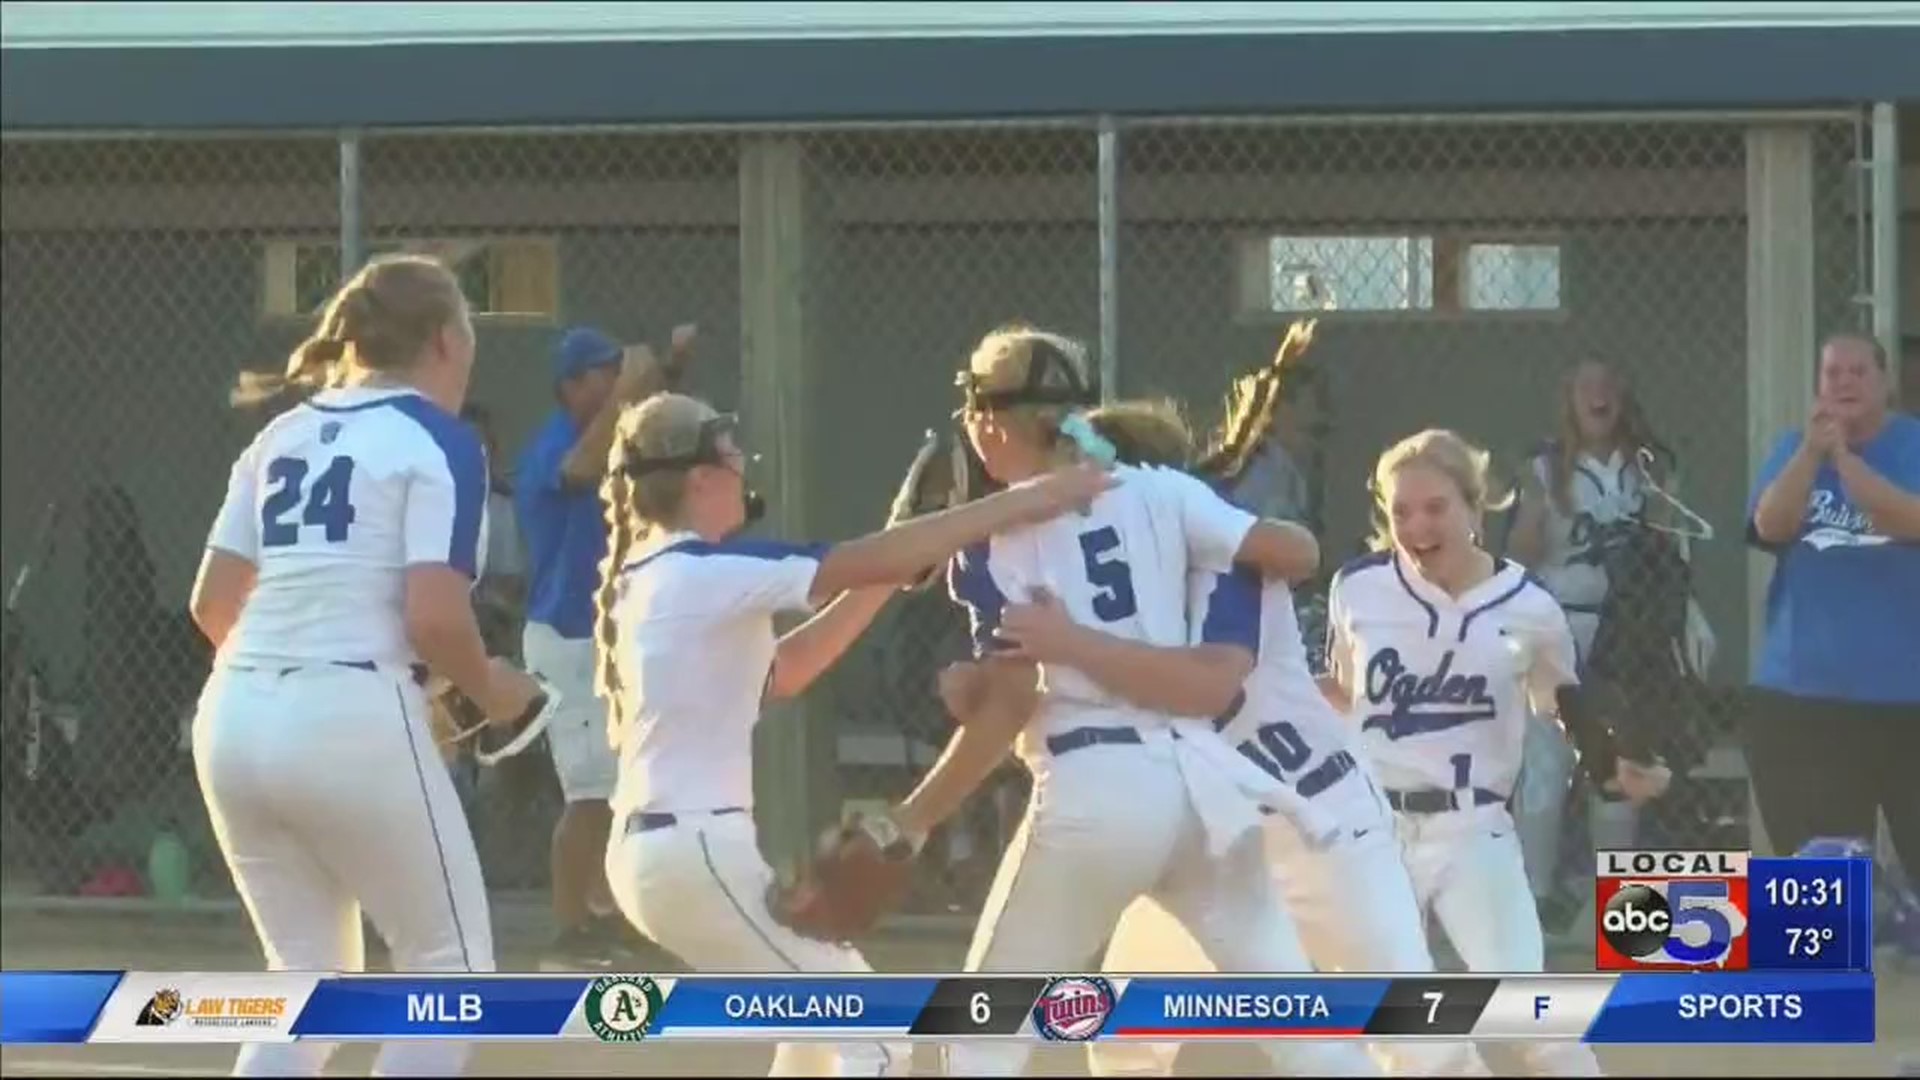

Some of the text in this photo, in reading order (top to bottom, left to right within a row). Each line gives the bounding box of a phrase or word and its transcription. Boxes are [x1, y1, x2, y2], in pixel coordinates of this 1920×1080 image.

[262, 455, 355, 547] 24
[1078, 525, 1138, 622] 5
[1365, 647, 1492, 718] Ogden
[1236, 720, 1312, 783] 10
[1450, 753, 1472, 789] 1
